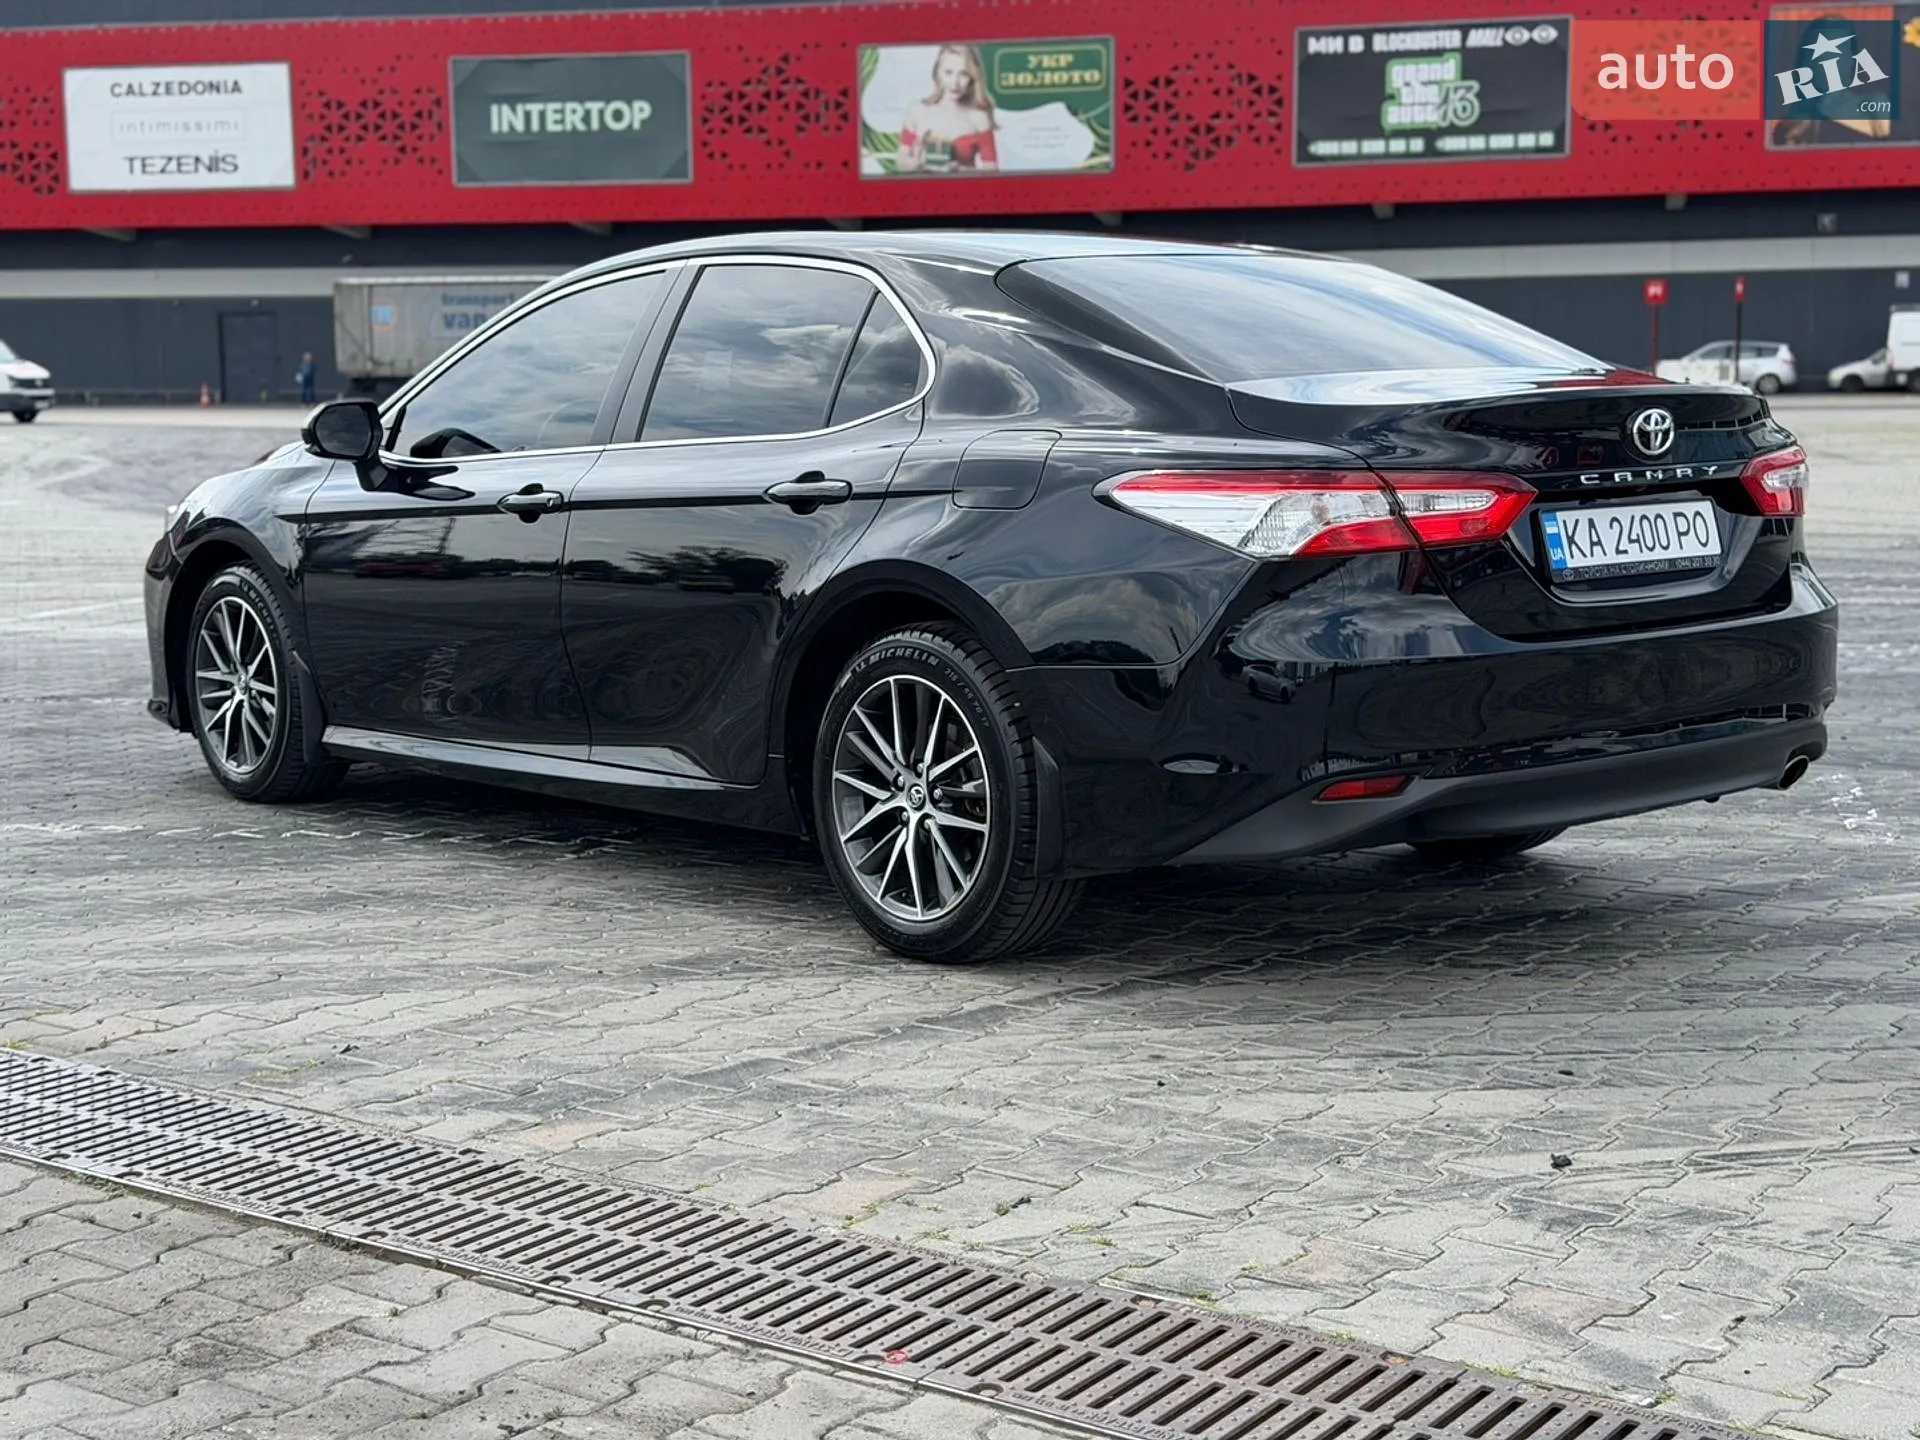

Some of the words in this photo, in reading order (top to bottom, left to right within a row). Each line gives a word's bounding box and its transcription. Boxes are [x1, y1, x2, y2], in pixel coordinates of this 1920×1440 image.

[1372, 29, 1462, 52] BLOCKBUSTER
[1464, 26, 1505, 48] MALL
[1027, 53, 1075, 69] УКР
[1000, 69, 1101, 87] ЗОЛОТО
[110, 79, 243, 98] CALZEDONIA
[119, 118, 239, 134] intimissimi
[489, 99, 653, 134] INTERTOP
[1580, 465, 1718, 485] CAMRY
[1562, 517, 1607, 560] KA
[1609, 512, 1671, 555] 2400
[1671, 509, 1710, 551] PO
[1550, 547, 1565, 561] UA
[869, 647, 940, 667] MICHELIN
